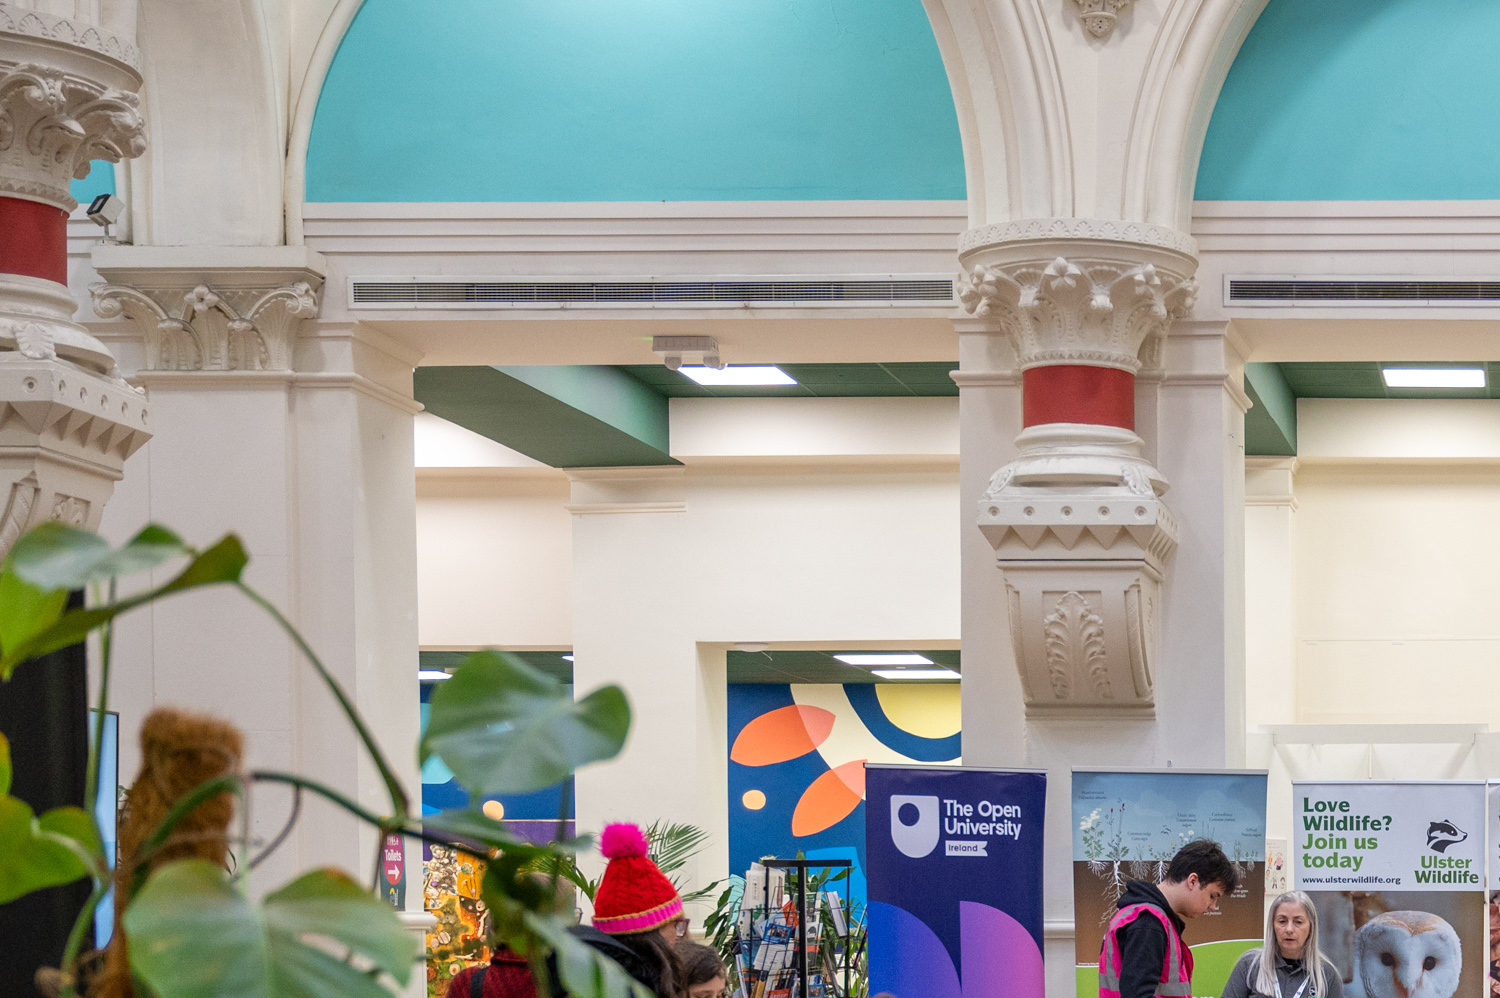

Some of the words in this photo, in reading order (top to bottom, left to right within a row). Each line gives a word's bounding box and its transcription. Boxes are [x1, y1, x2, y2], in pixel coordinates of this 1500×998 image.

[943, 800, 973, 817] The
[977, 801, 1021, 821] Open
[1303, 797, 1350, 813] Love
[944, 818, 1021, 840] University
[1303, 815, 1392, 831] Wildlife?
[948, 844, 978, 852] Ireland
[1302, 834, 1347, 850] Join
[1354, 837, 1378, 850] us
[384, 849, 402, 862] Toilets
[1302, 852, 1364, 872] today
[1420, 856, 1472, 868] Ulster
[1302, 876, 1401, 885] www.ulsterwildlife.org
[1414, 870, 1479, 884] Wildlife
